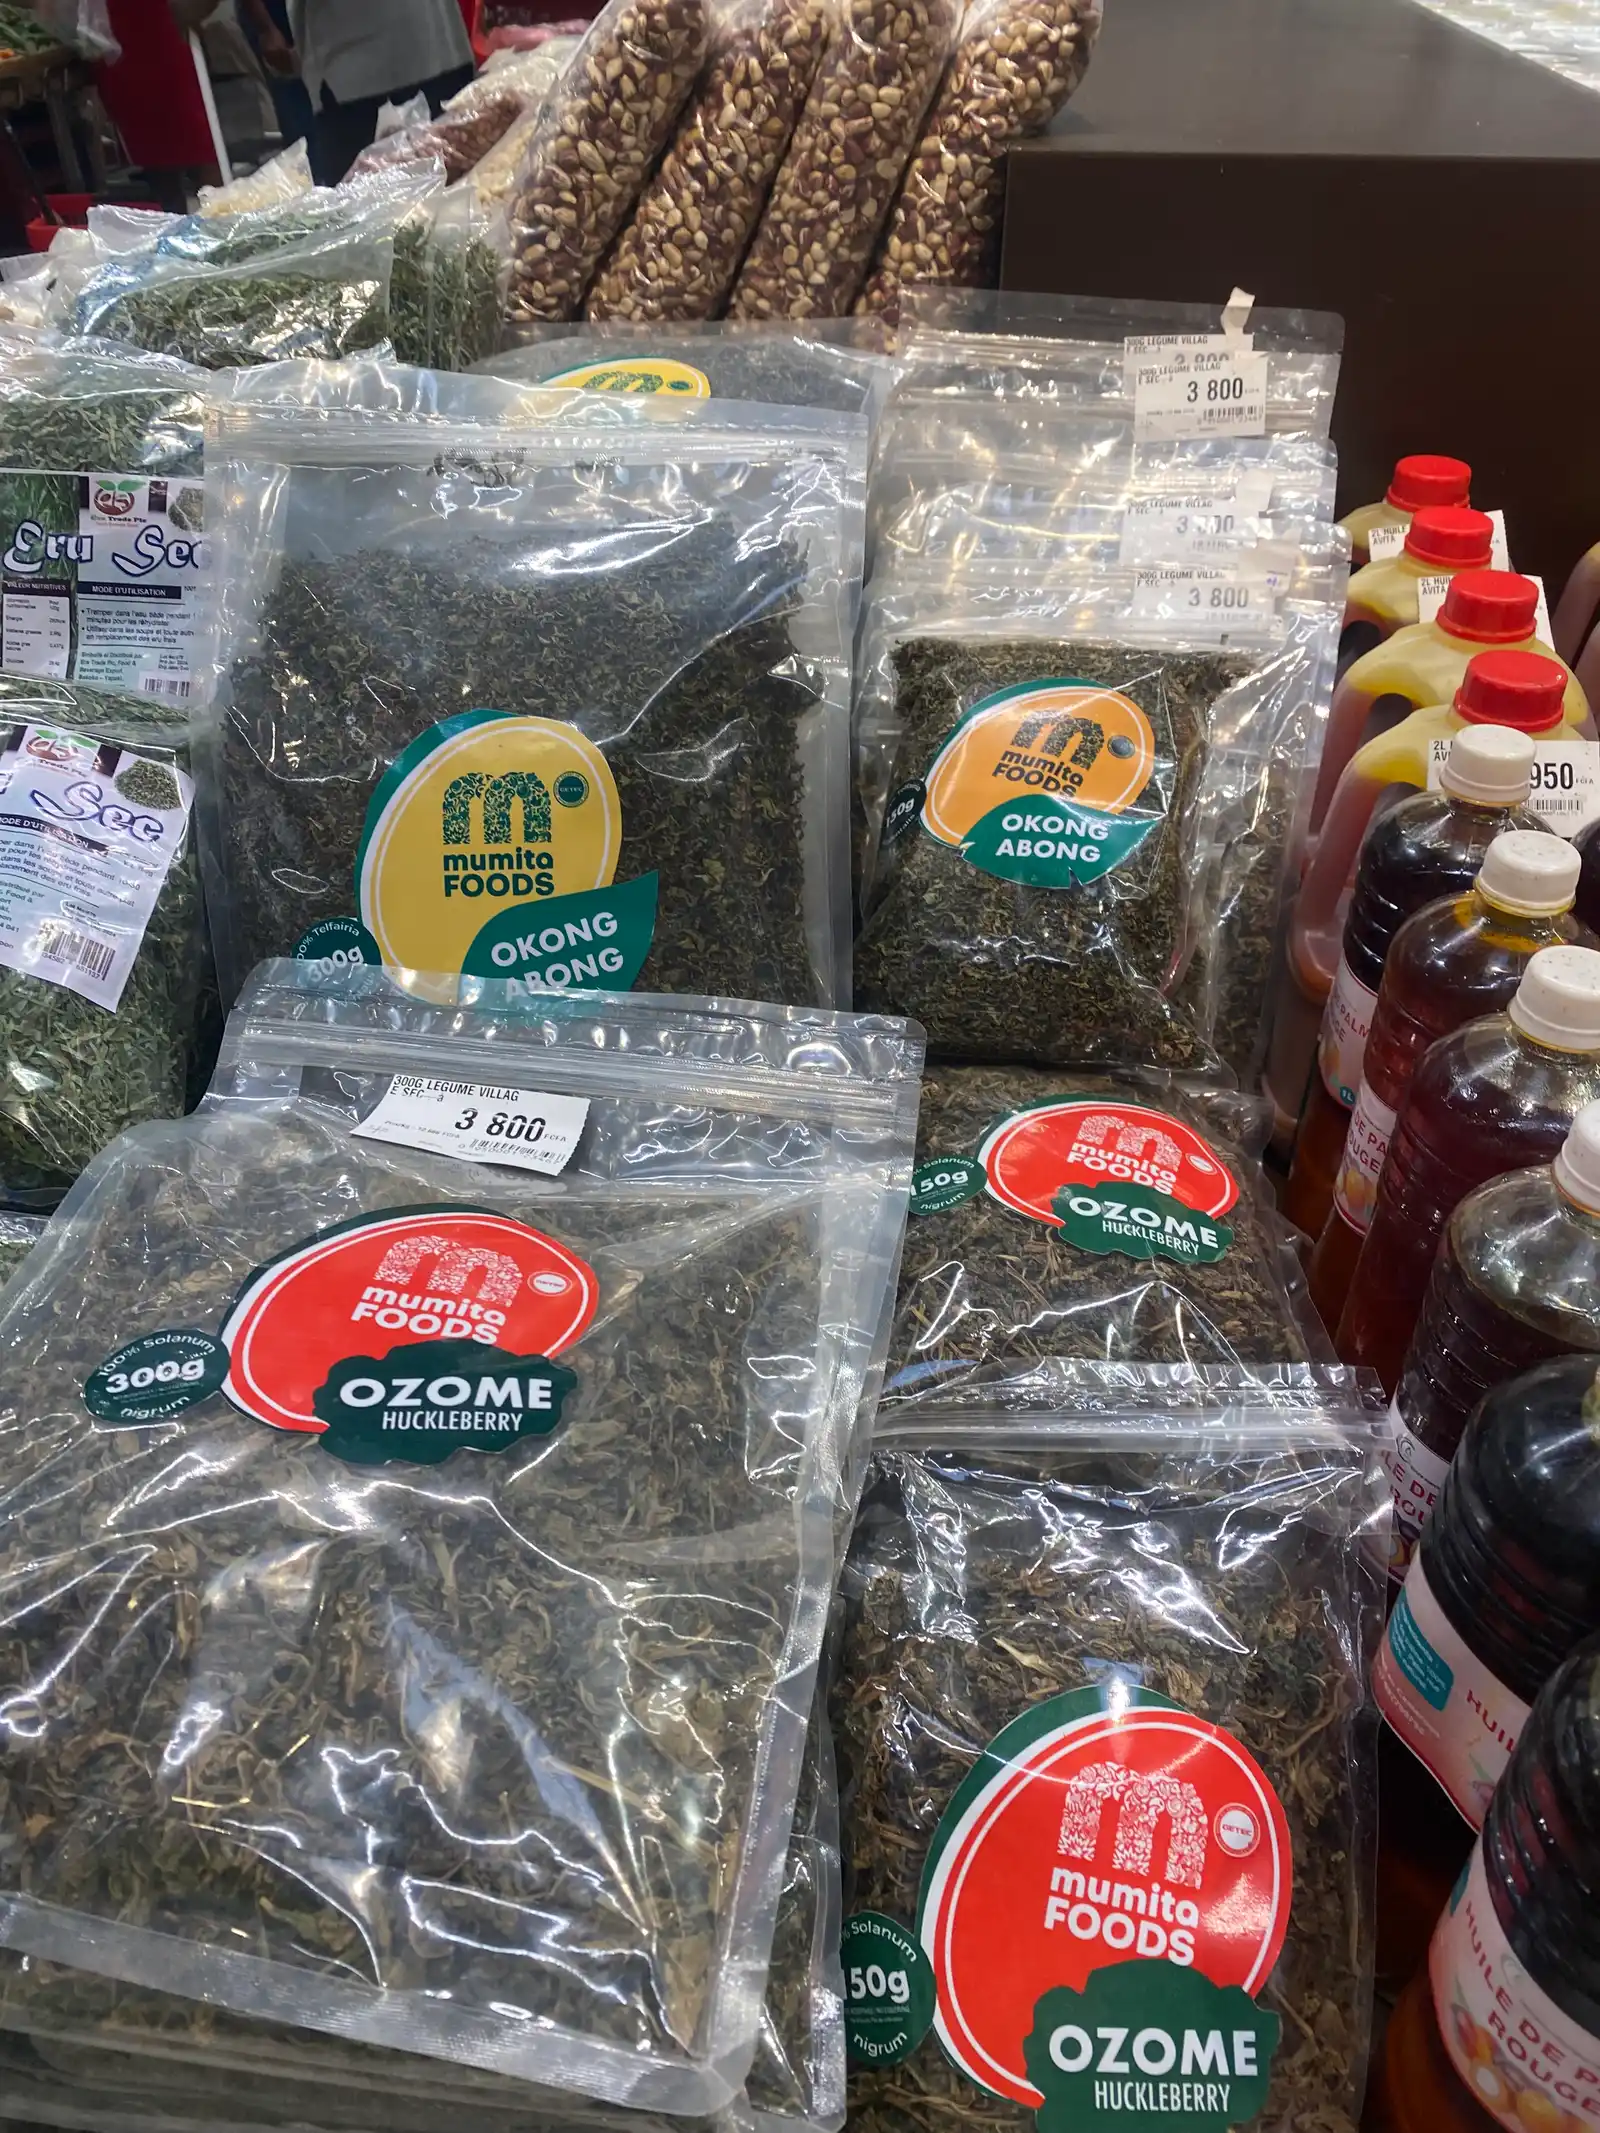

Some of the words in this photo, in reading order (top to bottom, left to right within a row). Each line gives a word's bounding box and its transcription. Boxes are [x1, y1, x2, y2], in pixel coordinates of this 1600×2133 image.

[1147, 336, 1178, 345] LEGUME
[1181, 335, 1208, 344] VILLAG
[1159, 365, 1191, 375] LEGUME
[1194, 363, 1221, 372] VILLAG
[1187, 380, 1198, 403] 3
[1207, 377, 1243, 401] 800
[1150, 498, 1182, 508] LEGUME
[1176, 515, 1189, 534] 3
[3, 519, 94, 573] Eru
[91, 585, 113, 593] MODE
[1160, 570, 1194, 580] LEGUME
[1196, 570, 1226, 579] VILLA
[1421, 578, 1432, 587] 2L
[1434, 576, 1451, 586] HUI
[1188, 587, 1201, 607] 3
[1210, 587, 1249, 608] 800
[1422, 586, 1447, 595] AVITA
[1433, 740, 1446, 751] 2L
[992, 763, 1078, 799] FOODS
[1001, 750, 1084, 787] mumita
[1529, 762, 1574, 790] 950
[29, 780, 165, 843] Sec
[886, 797, 915, 829] 150g
[1001, 813, 1110, 842] OKONG
[443, 847, 554, 872] mumita
[995, 838, 1101, 863] ABONG
[5, 889, 26, 902] Food
[444, 872, 555, 898] FOODS
[297, 935, 314, 962] 00%
[311, 921, 361, 937] Telfairia
[490, 911, 619, 968] OKONG
[504, 947, 625, 1001] ABONG
[393, 1075, 424, 1089] 300G
[425, 1080, 476, 1097] LEGUME
[479, 1086, 520, 1102] VILLAG
[454, 1107, 479, 1131] 3
[485, 1111, 547, 1143] 800
[1347, 1129, 1381, 1175] OUGE
[1367, 1131, 1388, 1157] PA
[923, 1157, 975, 1169] Solanum
[1066, 1153, 1174, 1196] FOODS
[1071, 1141, 1178, 1183] mumita
[910, 1170, 969, 1196] 150g
[920, 1192, 966, 1210] nigrum
[1069, 1196, 1219, 1249] OZOME
[1102, 1220, 1200, 1256] HUCKLEBERRY
[362, 1285, 507, 1328] mumita
[350, 1301, 500, 1346] FOODS
[97, 1345, 141, 1377] 100%
[143, 1334, 217, 1354] Solanum
[105, 1357, 206, 1394] 300g
[120, 1396, 191, 1420] nigrum
[339, 1376, 553, 1411] OZOME
[381, 1410, 524, 1432] HUCKLEBERRY
[1410, 1480, 1437, 1507] DE
[1049, 1866, 1200, 1930] mumita
[851, 1920, 918, 1963] Solanum
[1044, 1897, 1196, 1967] FOODS
[850, 1964, 911, 2004] 50g
[1465, 1901, 1514, 2015] HUILE
[1518, 2017, 1567, 2068] DE
[1574, 2066, 1600, 2091] P
[853, 2031, 909, 2058] nigrum
[1049, 2024, 1259, 2079] OZOME
[1094, 2079, 1231, 2114] HUCKLEBERRY
